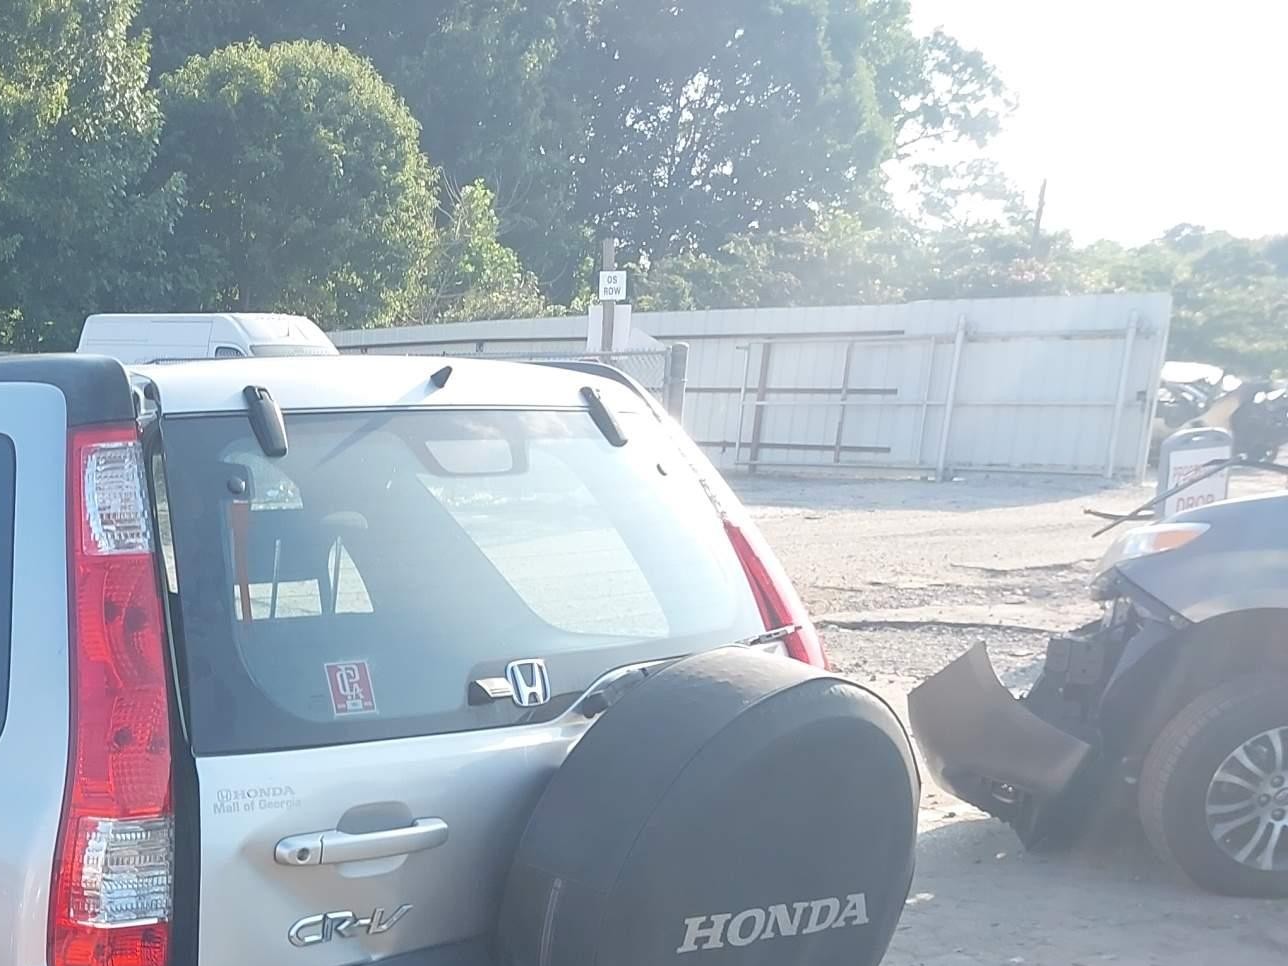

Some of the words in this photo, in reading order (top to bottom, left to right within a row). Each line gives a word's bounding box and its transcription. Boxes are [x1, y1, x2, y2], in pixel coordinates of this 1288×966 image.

[607, 275, 618, 285] OS
[603, 286, 622, 297] ROW
[233, 785, 296, 801] HONDA
[213, 801, 240, 814] Mall
[243, 800, 255, 812] of
[258, 798, 301, 811] Georgia
[288, 903, 413, 948] CR-V
[676, 892, 870, 954] HONDA
